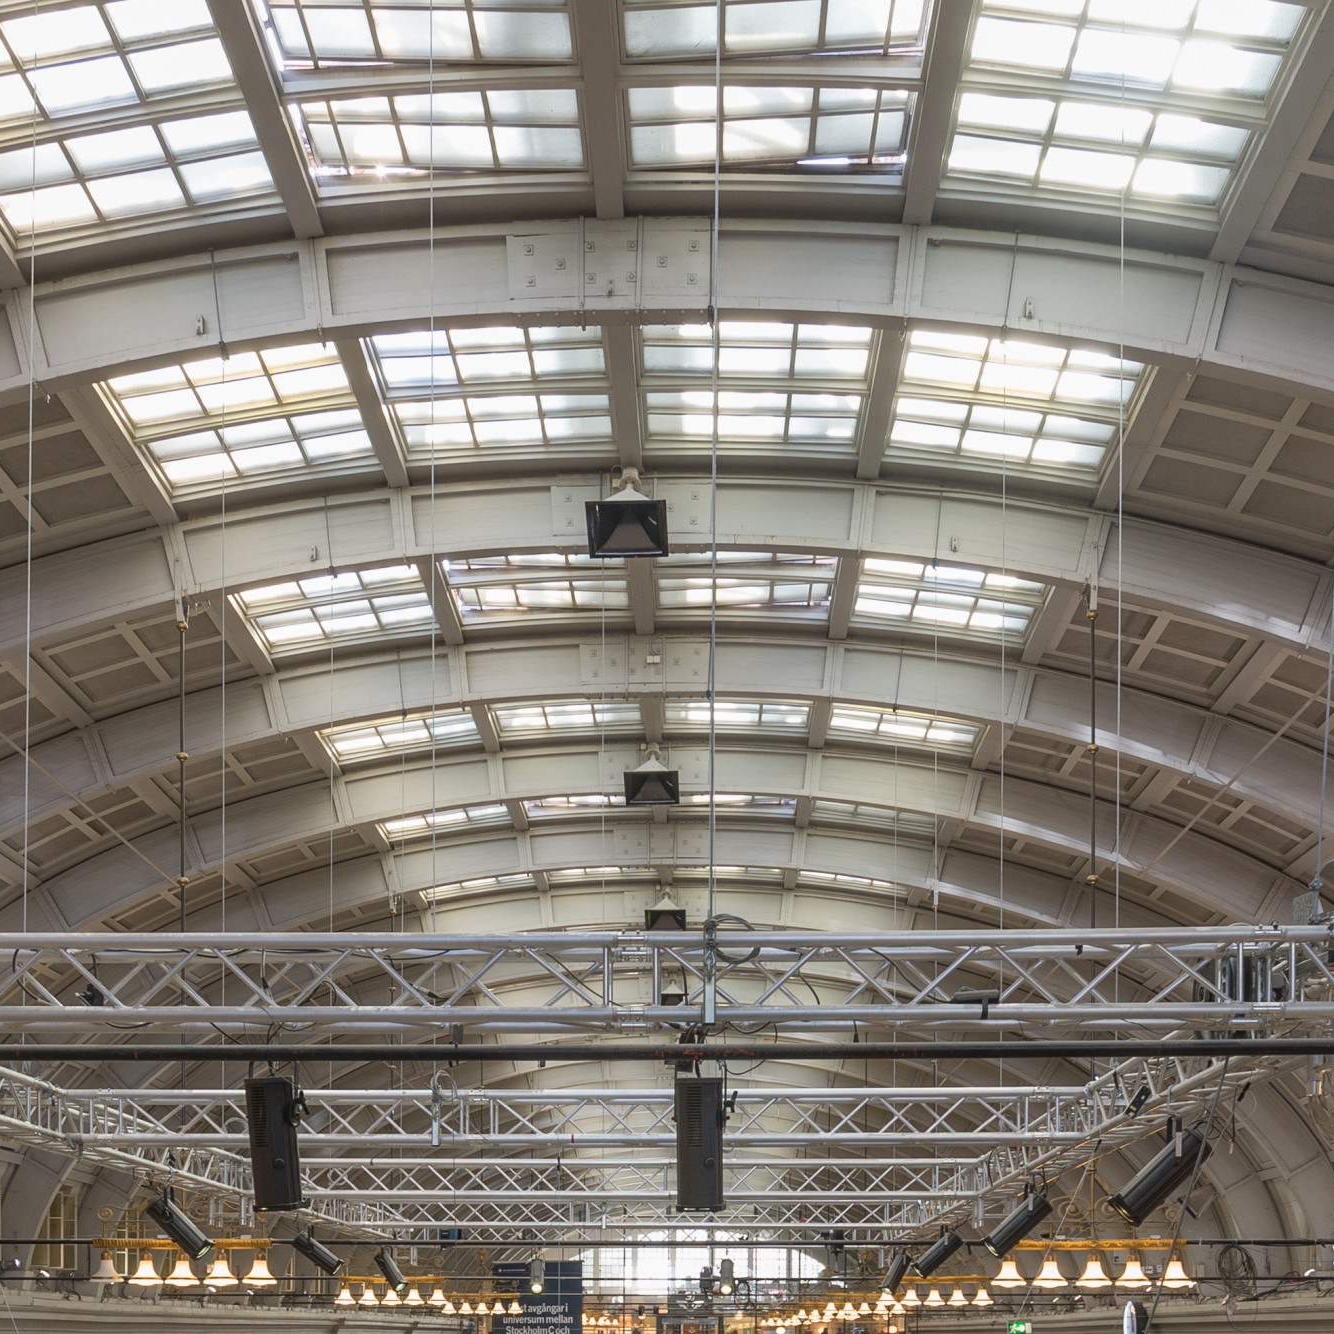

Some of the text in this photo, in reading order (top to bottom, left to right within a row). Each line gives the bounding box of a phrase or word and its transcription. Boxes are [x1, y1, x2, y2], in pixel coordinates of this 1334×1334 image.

[527, 1303, 564, 1315] avgångar
[503, 1314, 574, 1324] universum mellan
[505, 1326, 571, 1334] Stockholm C och
